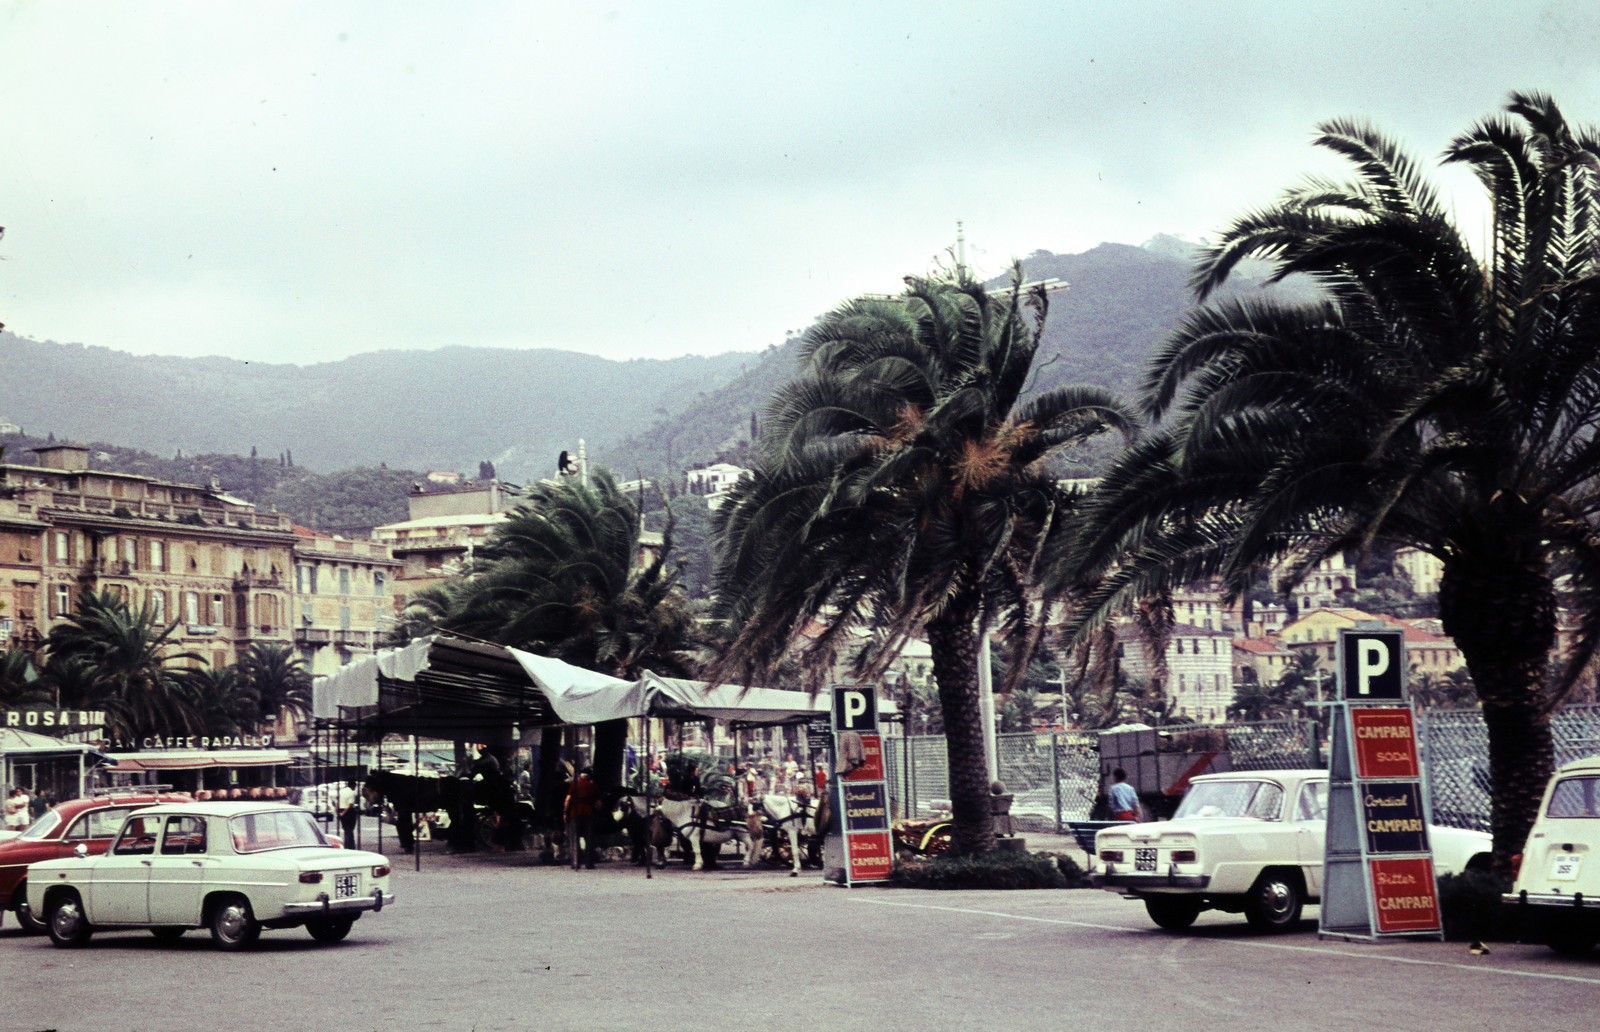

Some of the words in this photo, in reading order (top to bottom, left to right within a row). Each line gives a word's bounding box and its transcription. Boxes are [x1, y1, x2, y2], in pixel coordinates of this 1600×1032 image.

[1358, 638, 1389, 695] P
[844, 690, 867, 728] P
[7, 711, 69, 726] ROSA
[1357, 726, 1411, 739] CAMPARI
[1376, 751, 1411, 762] SODA
[1364, 794, 1407, 807] Cordial
[847, 807, 885, 817] CAMPARI
[1368, 819, 1423, 832] CAMPARI
[852, 856, 889, 866] CAMPARI
[1376, 871, 1417, 884] Bitter
[1380, 896, 1434, 910] CAMPARI
